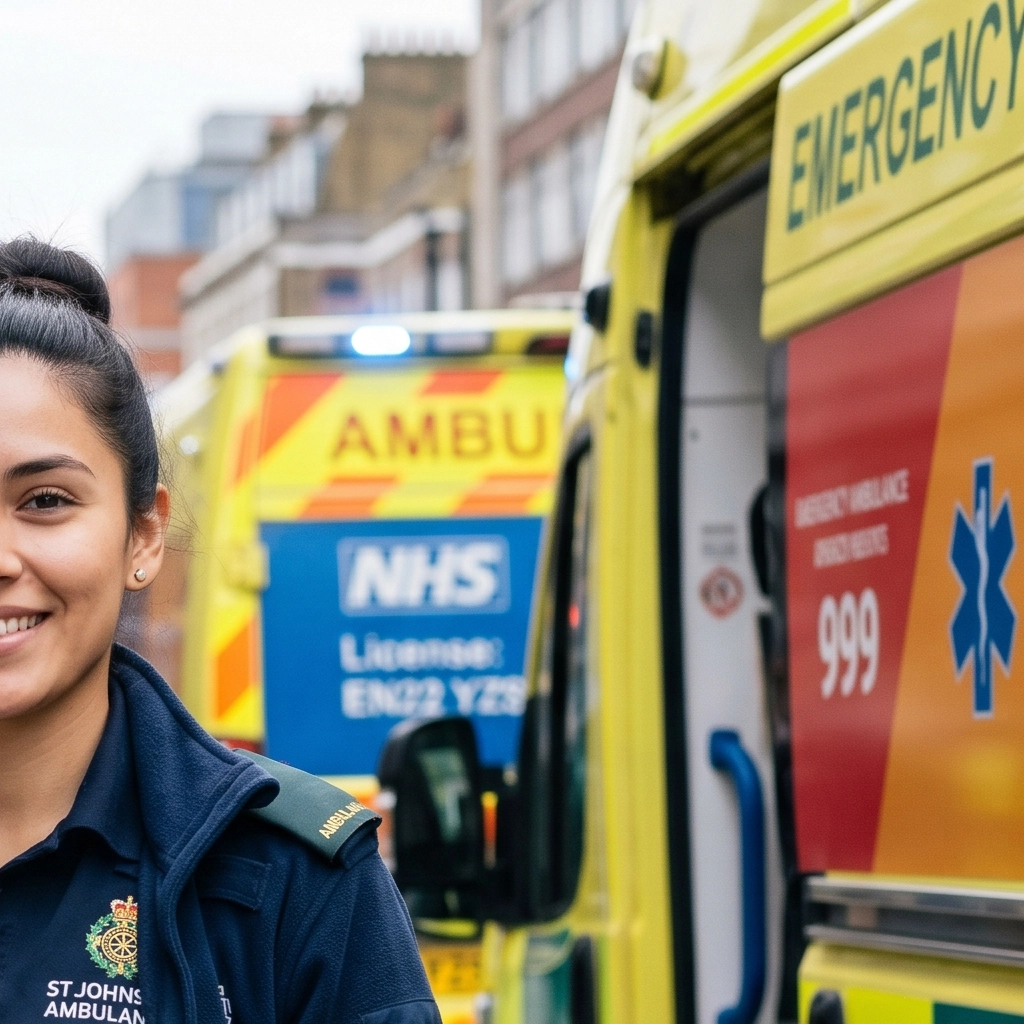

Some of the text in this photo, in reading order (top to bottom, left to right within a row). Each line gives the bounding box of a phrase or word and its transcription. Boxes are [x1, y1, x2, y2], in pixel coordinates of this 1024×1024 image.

[786, 0, 1024, 232] EMERGENCY
[332, 410, 547, 460] AMBU
[345, 541, 504, 610] NHS
[817, 587, 880, 700] 999
[46, 980, 143, 1006] ST JOHNS
